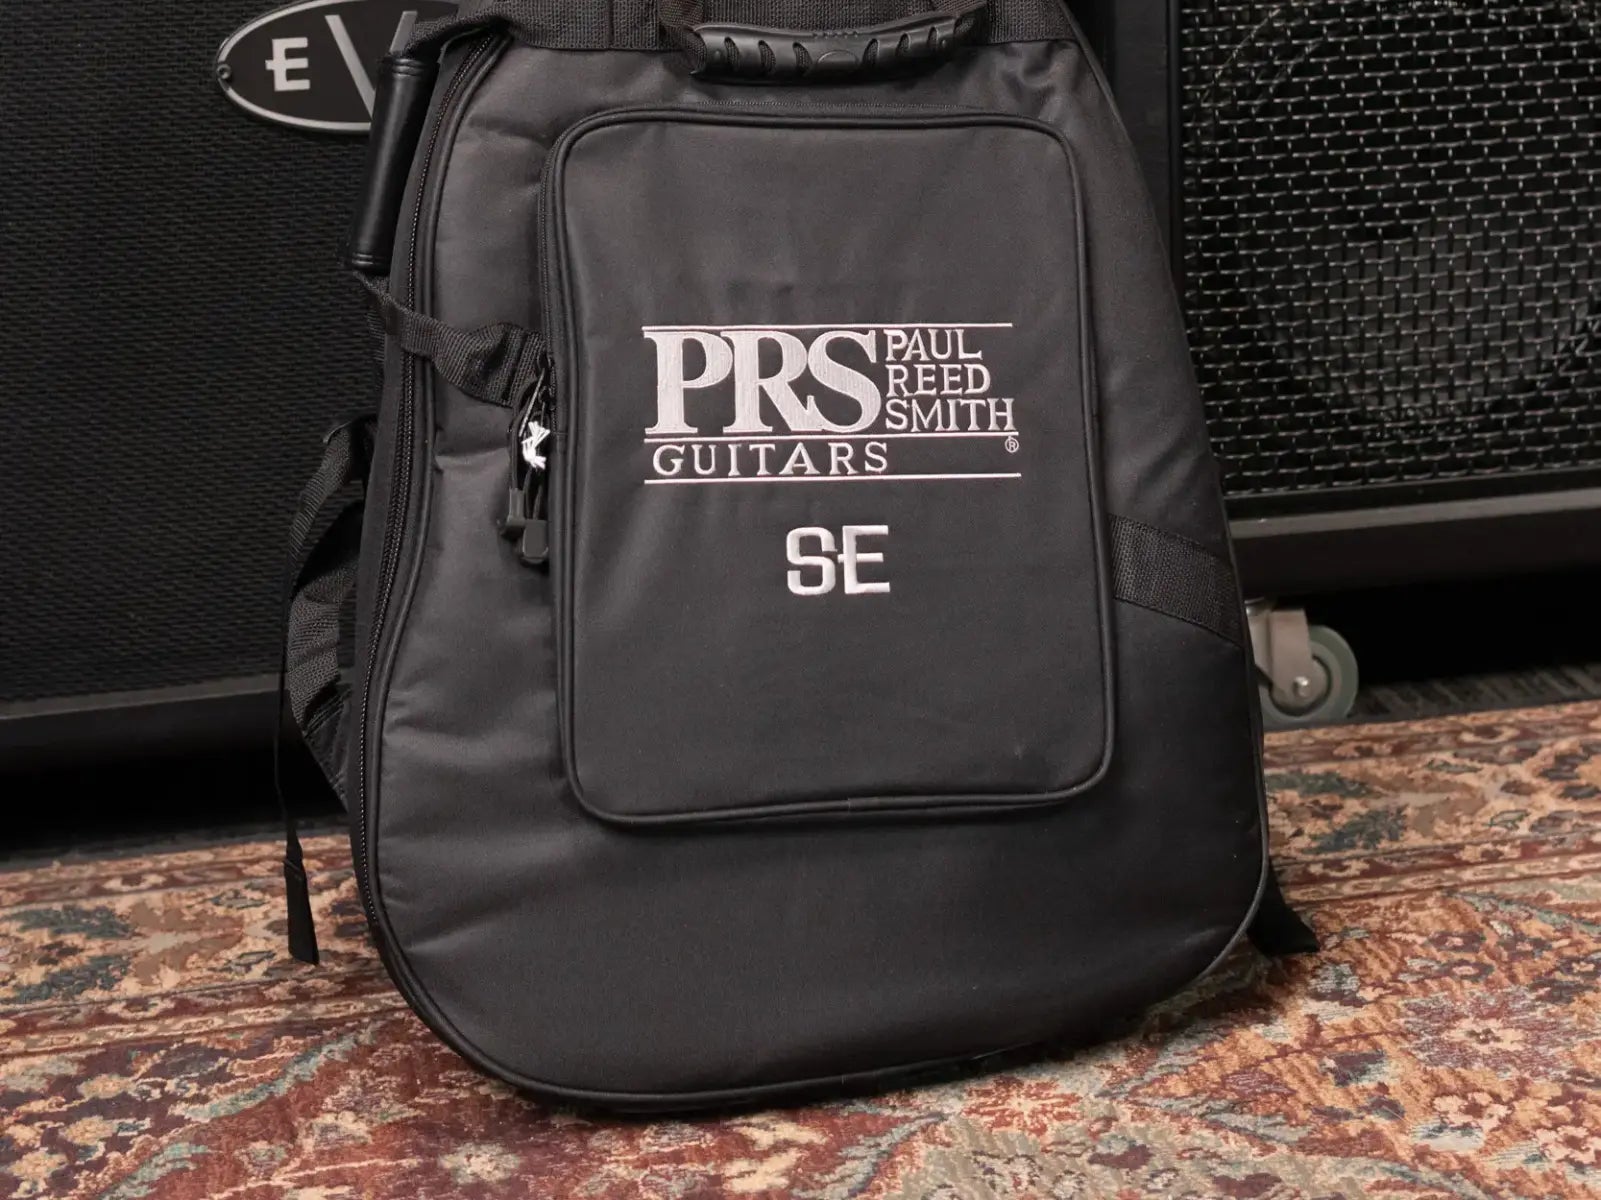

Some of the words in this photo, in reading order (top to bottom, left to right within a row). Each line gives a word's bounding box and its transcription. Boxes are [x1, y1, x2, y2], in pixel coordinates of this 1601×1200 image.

[883, 328, 983, 362] PAUL
[643, 329, 882, 435] PRS
[885, 363, 992, 399] REED
[885, 397, 1017, 433] SMITH
[652, 440, 889, 477] GUITARS
[786, 524, 891, 597] SE
